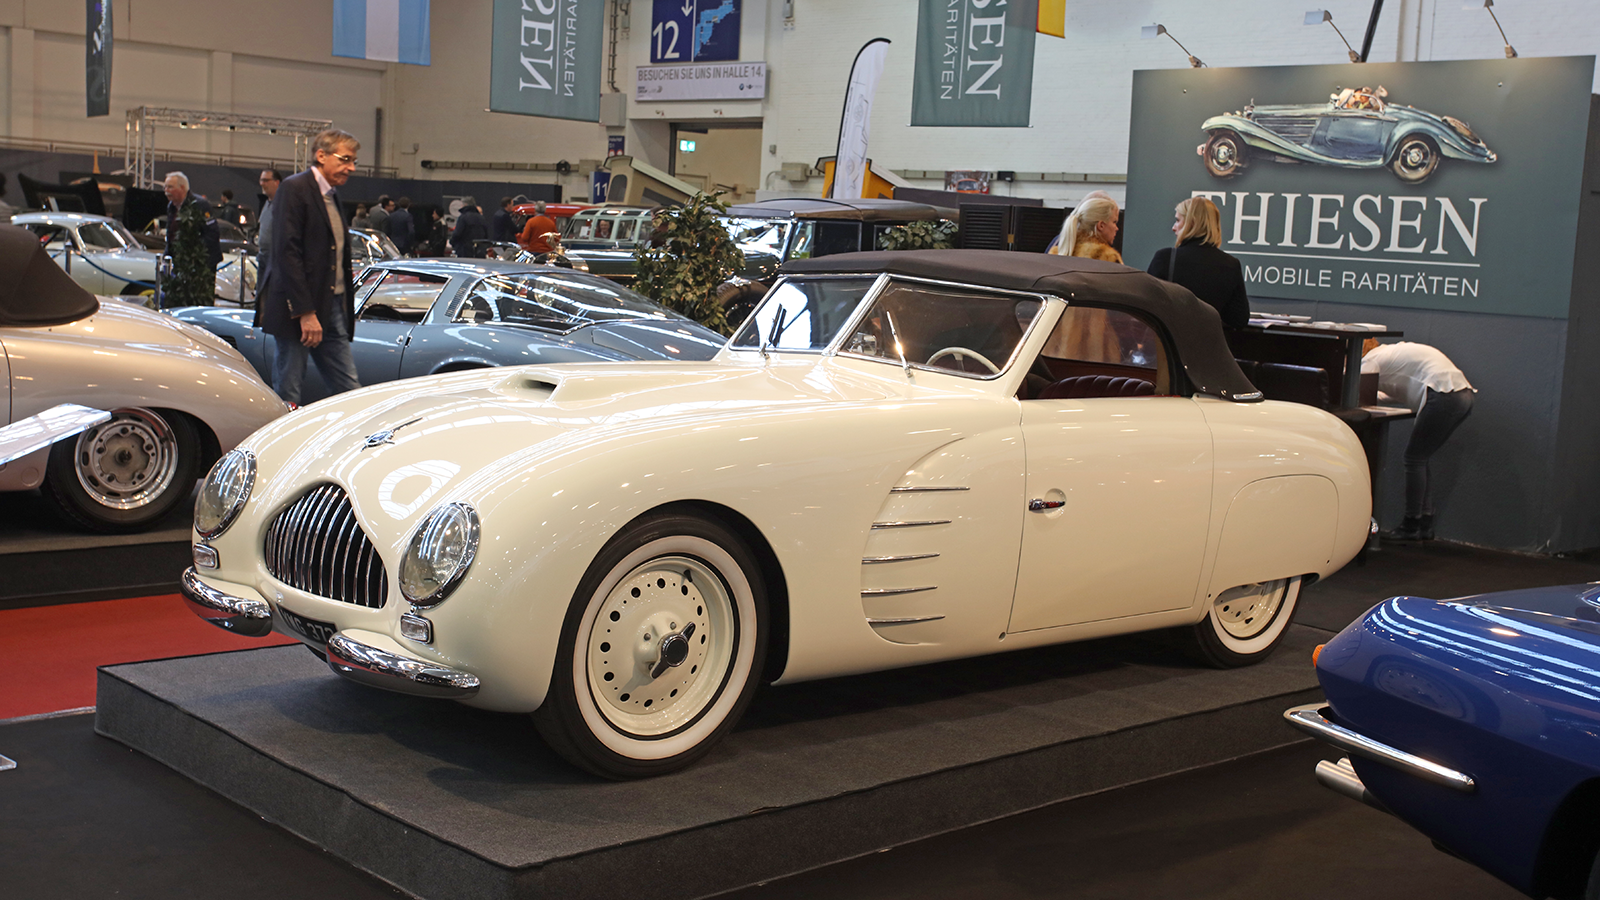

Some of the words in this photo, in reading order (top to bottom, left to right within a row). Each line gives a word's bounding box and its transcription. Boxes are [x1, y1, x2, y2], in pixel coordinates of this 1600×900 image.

[652, 20, 680, 60] 12
[964, 0, 1007, 100] EN
[638, 68, 680, 82] BESUCHEN
[680, 68, 694, 79] SIE
[694, 67, 712, 79] UNS
[712, 67, 722, 79] IN
[722, 66, 749, 78] HALLE
[751, 66, 763, 78] 14.
[594, 181, 608, 197] 11
[1341, 271, 1479, 298] RARITÄTEN
